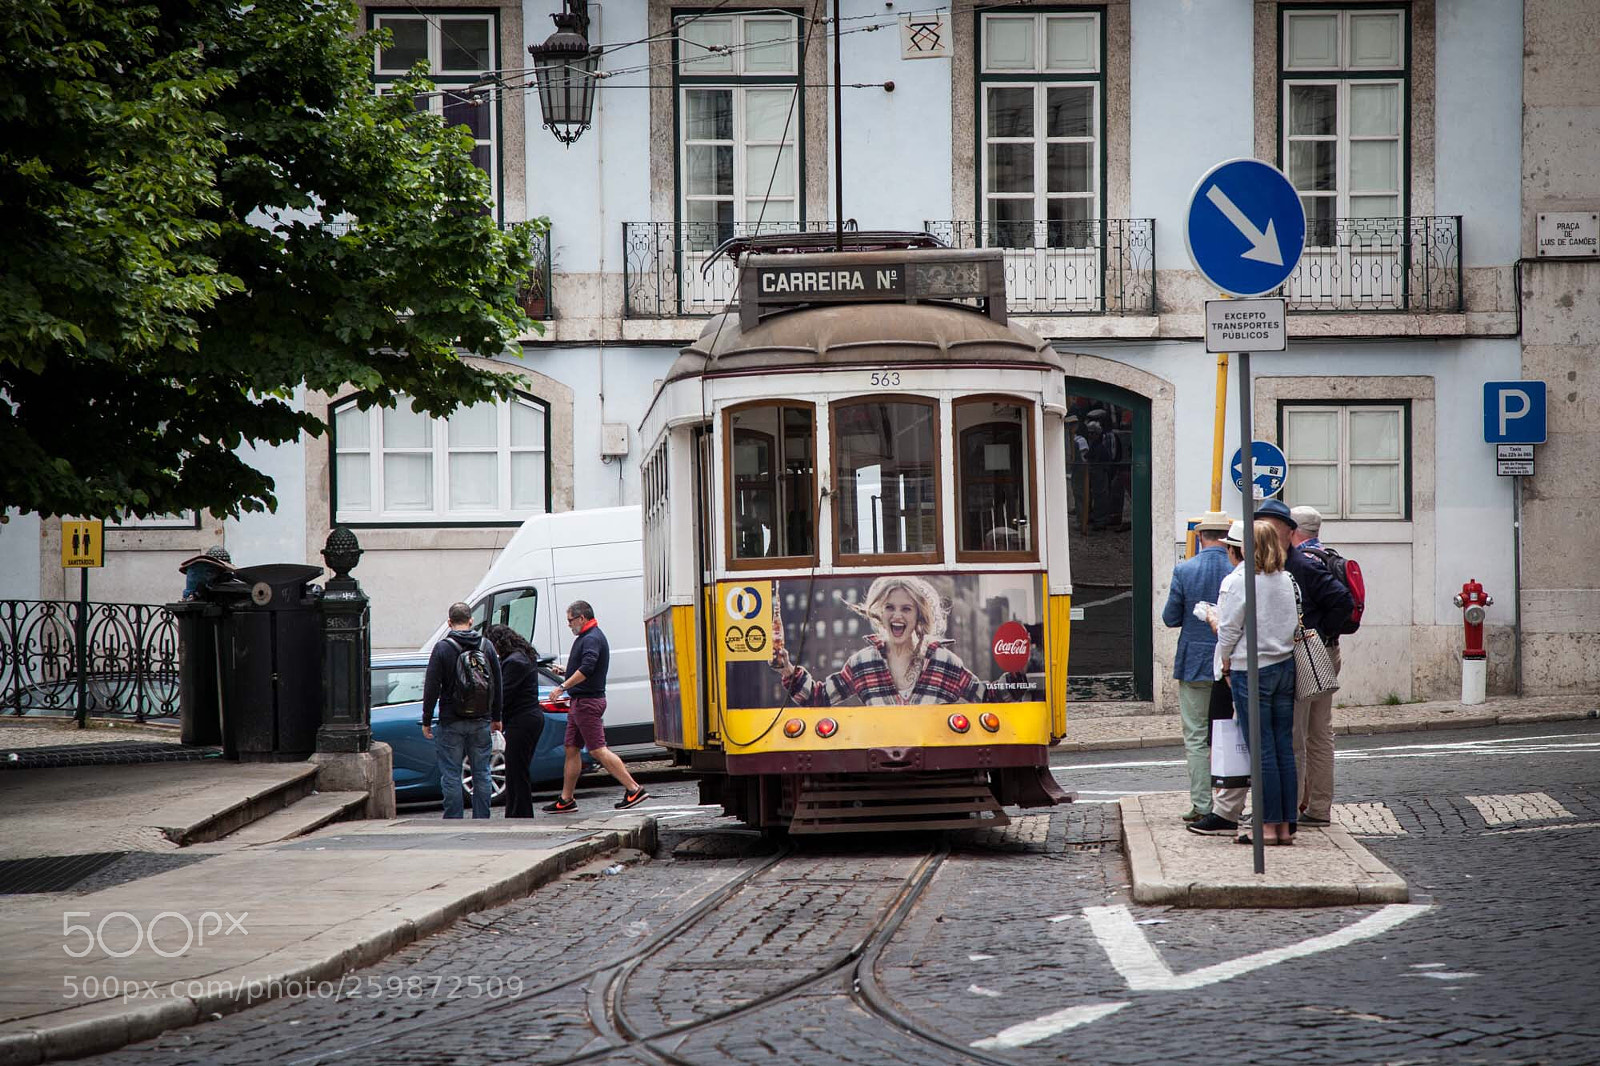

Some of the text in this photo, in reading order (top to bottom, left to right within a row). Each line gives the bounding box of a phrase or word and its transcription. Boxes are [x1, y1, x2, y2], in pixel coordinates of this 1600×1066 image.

[1556, 222, 1580, 231] PRAÇA
[1564, 230, 1573, 238] DE
[1557, 238, 1567, 246] DE
[762, 270, 865, 292] CARREIRA
[1224, 311, 1266, 320] EXCEPTO
[1211, 321, 1280, 331] TRANSPORTES
[1222, 330, 1269, 340] PÚBLICOS
[870, 372, 901, 386] 563
[1498, 388, 1532, 436] P
[994, 639, 1028, 655] Coca-Cola
